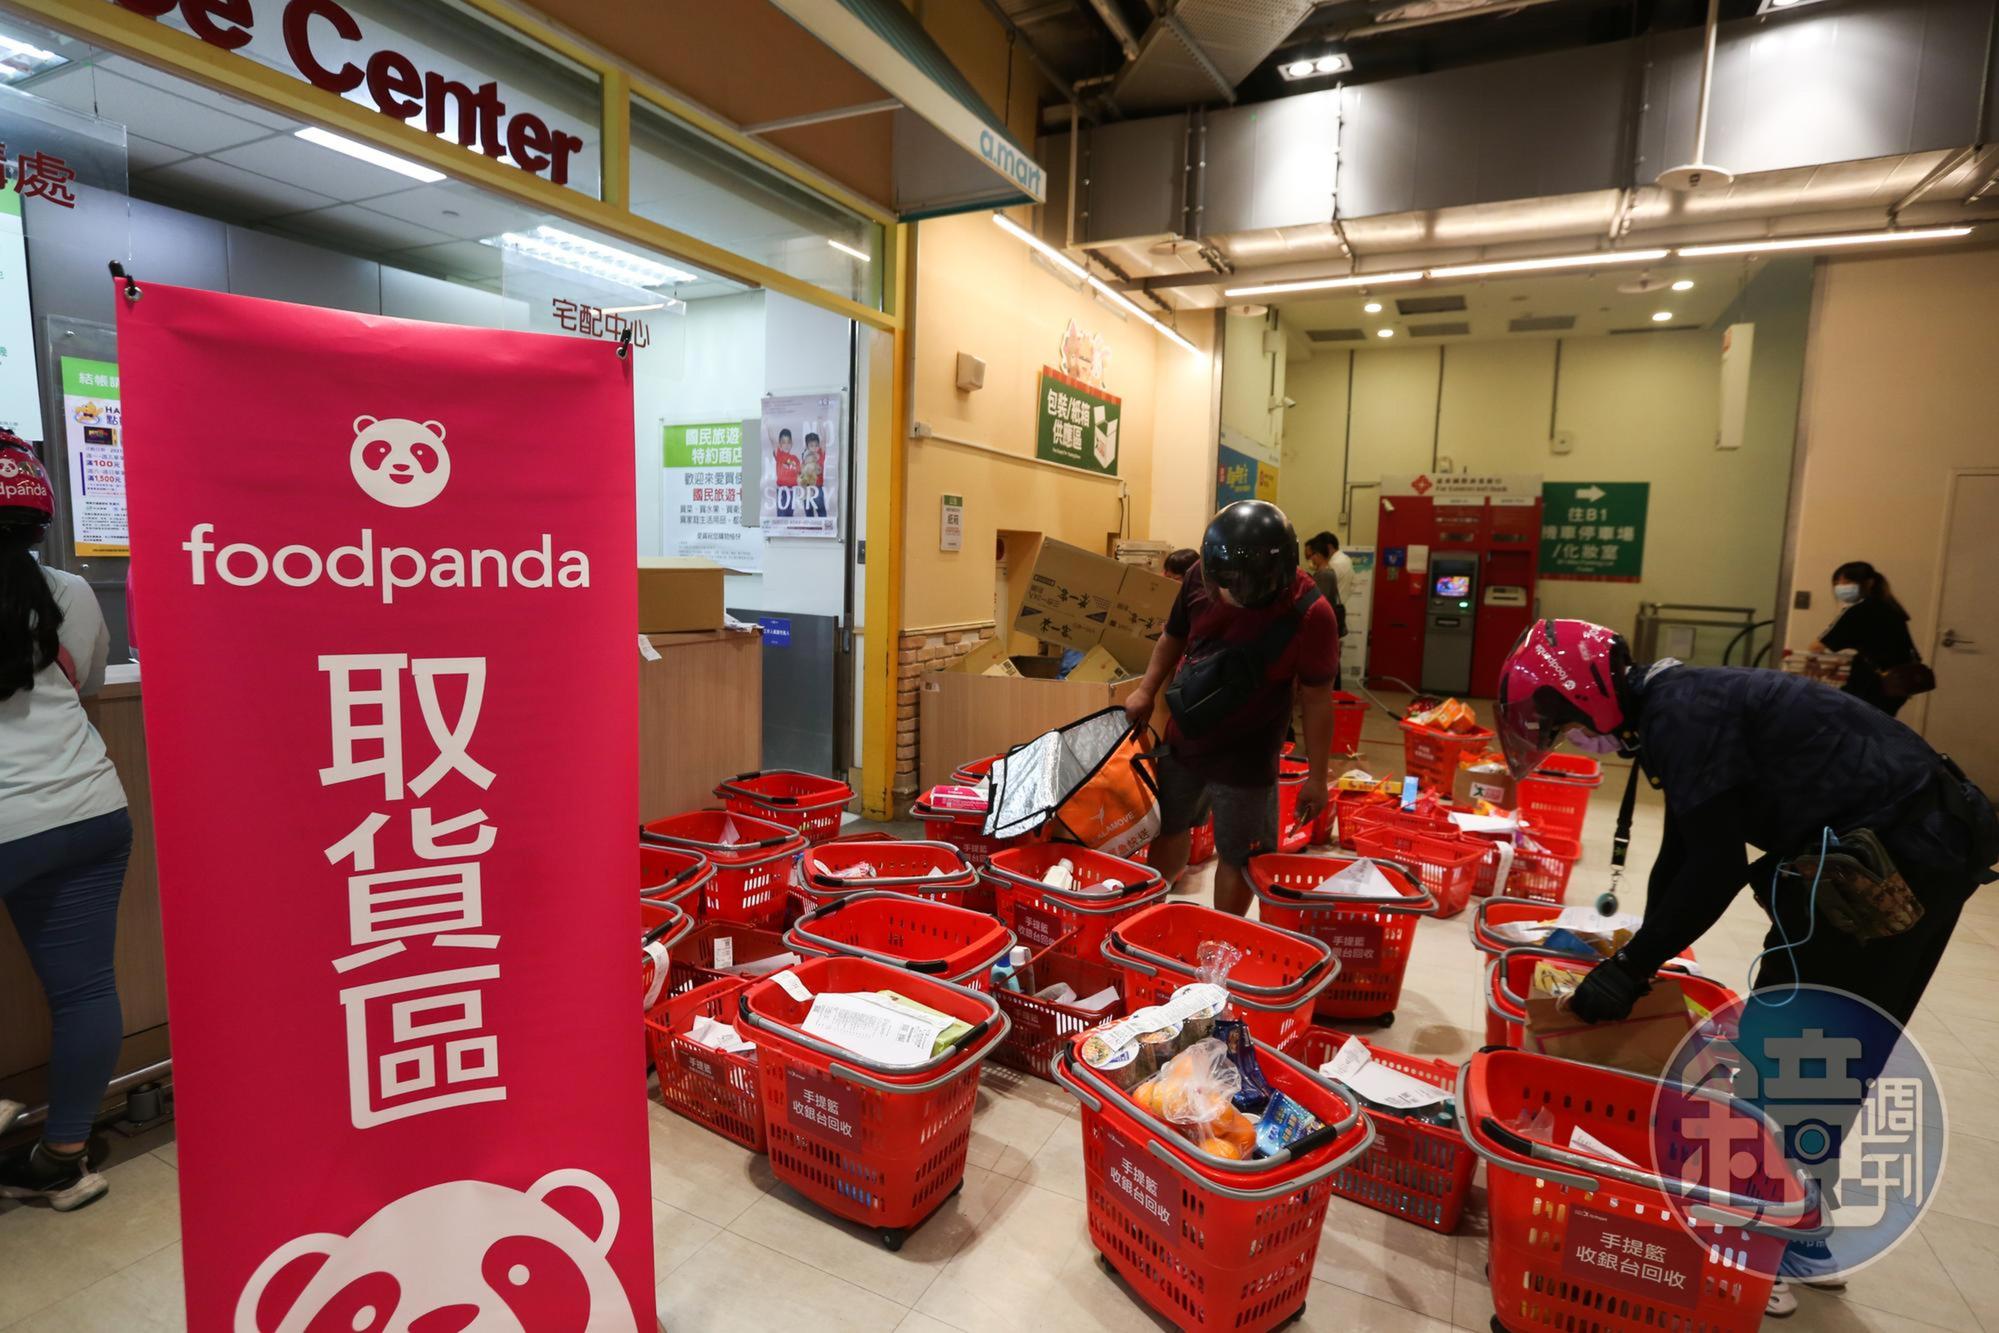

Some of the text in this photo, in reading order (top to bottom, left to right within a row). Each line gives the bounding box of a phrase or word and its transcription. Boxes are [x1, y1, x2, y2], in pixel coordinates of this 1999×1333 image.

[283, 0, 583, 185] Center
[980, 129, 1041, 196] a.mart
[553, 298, 650, 348] 宅配中心
[1047, 388, 1090, 428] 包裝/紙箱
[686, 427, 742, 446] 國民旅遊
[1052, 418, 1083, 450] 供應區
[764, 486, 835, 510] SORRY
[1568, 507, 1607, 522] 往B1
[182, 523, 591, 604] foodpanda
[318, 653, 507, 1129] 取貨區
[1025, 916, 1048, 934] 手提籃
[793, 1100, 852, 1138] 收銀台回收
[803, 1089, 839, 1115] 手提籃
[1110, 1167, 1170, 1226] 收銀台回收
[1121, 1158, 1158, 1197] 手提籃
[1600, 1232, 1667, 1263] 手提籃
[1576, 1246, 1686, 1289] 收銀台回收
